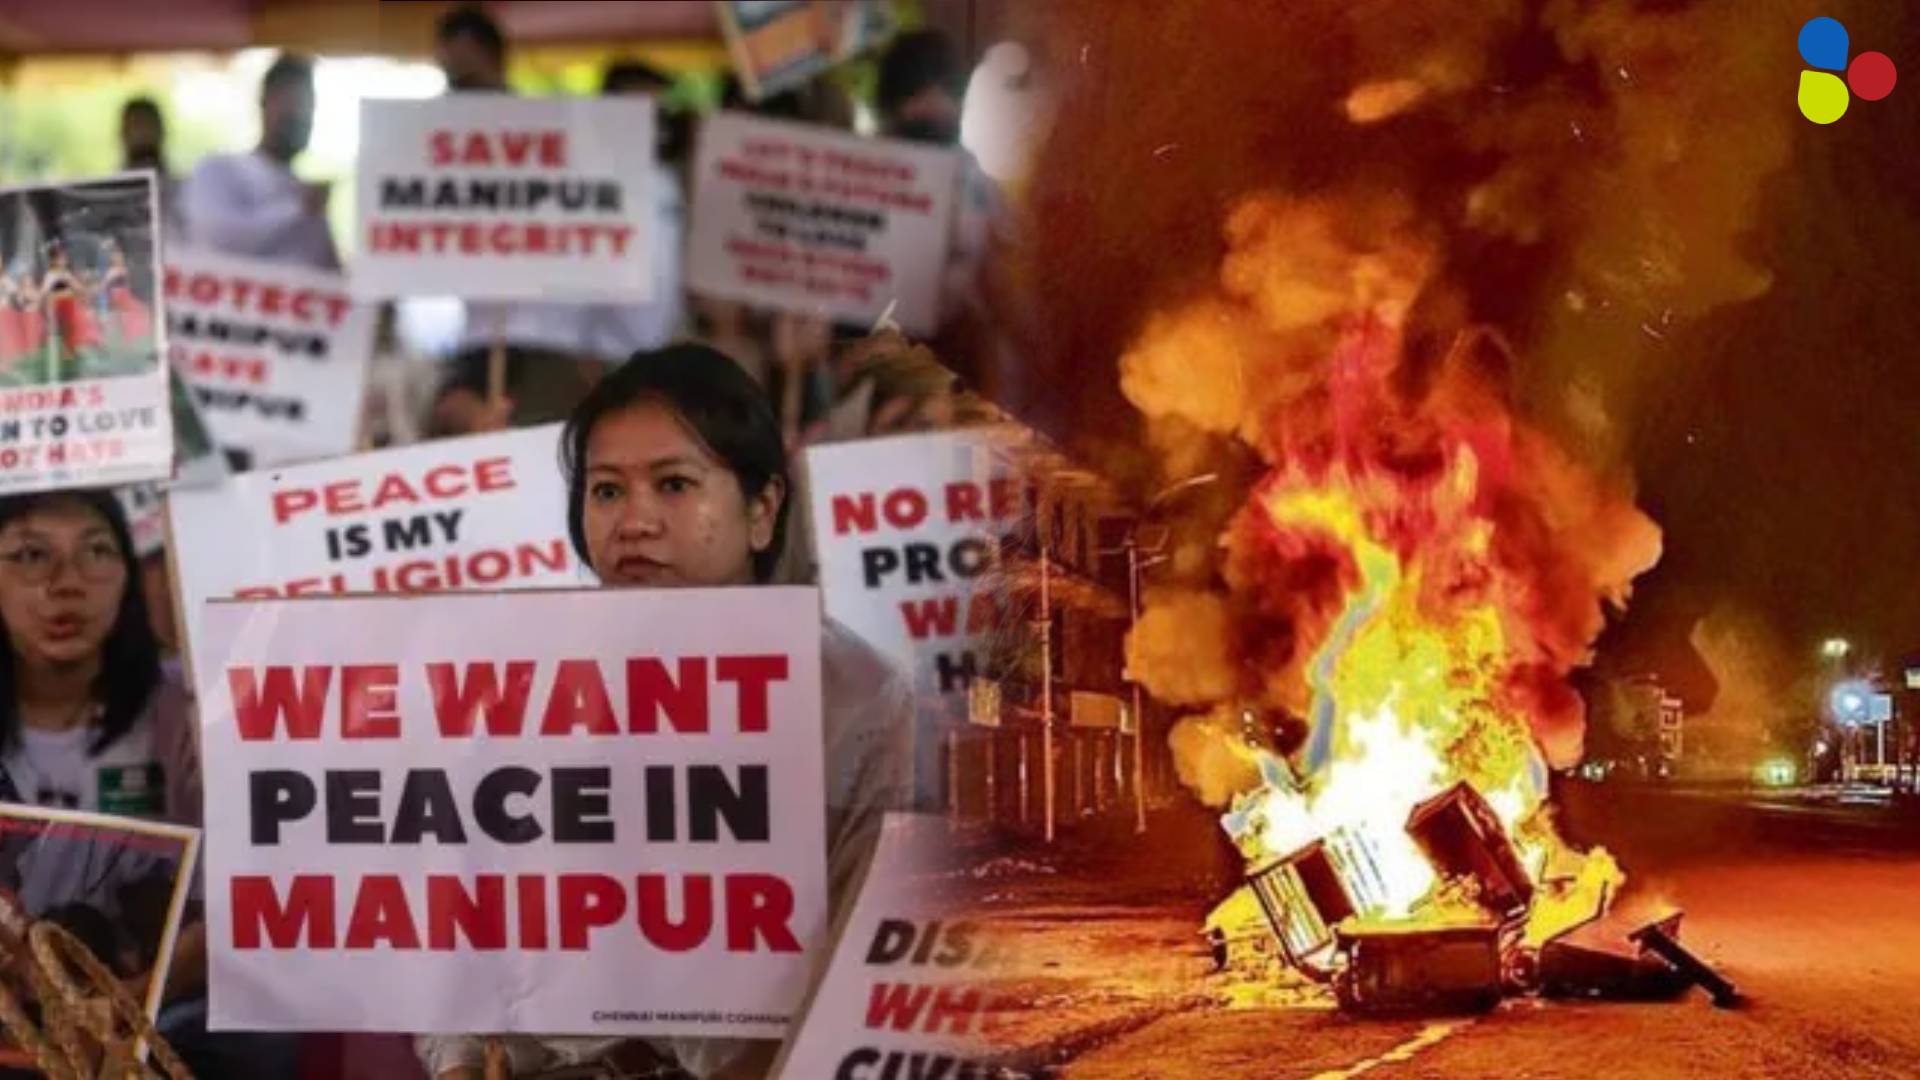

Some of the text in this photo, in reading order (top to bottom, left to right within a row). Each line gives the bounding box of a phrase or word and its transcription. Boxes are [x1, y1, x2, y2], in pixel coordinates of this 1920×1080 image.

[430, 129, 567, 166] SAVE
[380, 178, 622, 212] MANIPUR
[368, 222, 635, 257] INTEGRITY
[31, 414, 69, 438] TO
[78, 407, 155, 433] LOVE
[272, 456, 516, 525] PEACE
[832, 487, 928, 536] NO
[326, 508, 465, 561] IS MY
[228, 655, 788, 741] WE WANT
[249, 766, 614, 845] PEACE
[645, 765, 771, 842] IN
[230, 873, 804, 953] MANIPUR
[592, 1010, 652, 1023] CHENNAI
[656, 1011, 722, 1024] MANIPURI
